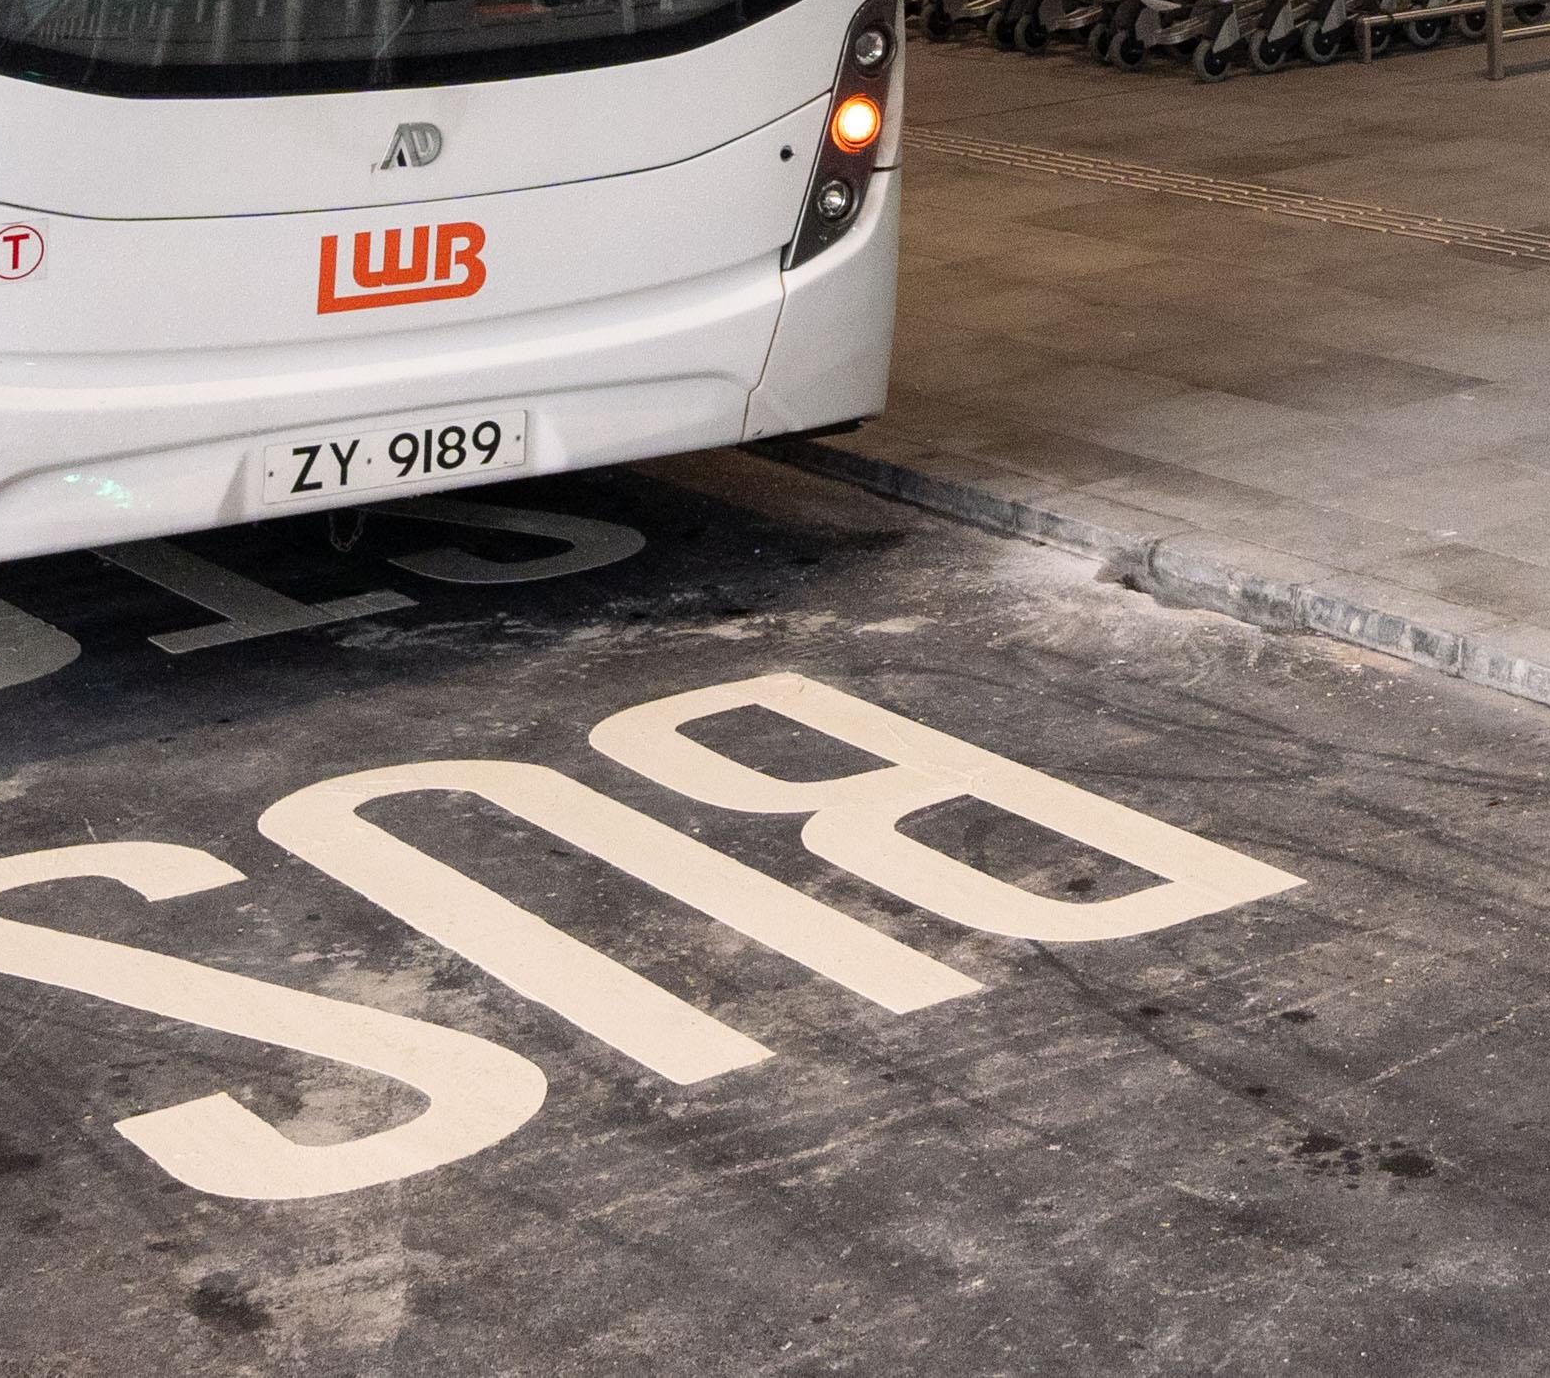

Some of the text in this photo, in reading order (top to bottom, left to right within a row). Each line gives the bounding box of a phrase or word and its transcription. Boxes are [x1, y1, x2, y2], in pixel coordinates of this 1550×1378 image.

[1, 233, 31, 268] T
[316, 221, 487, 315] LWB
[290, 421, 503, 494] ZY 9189
